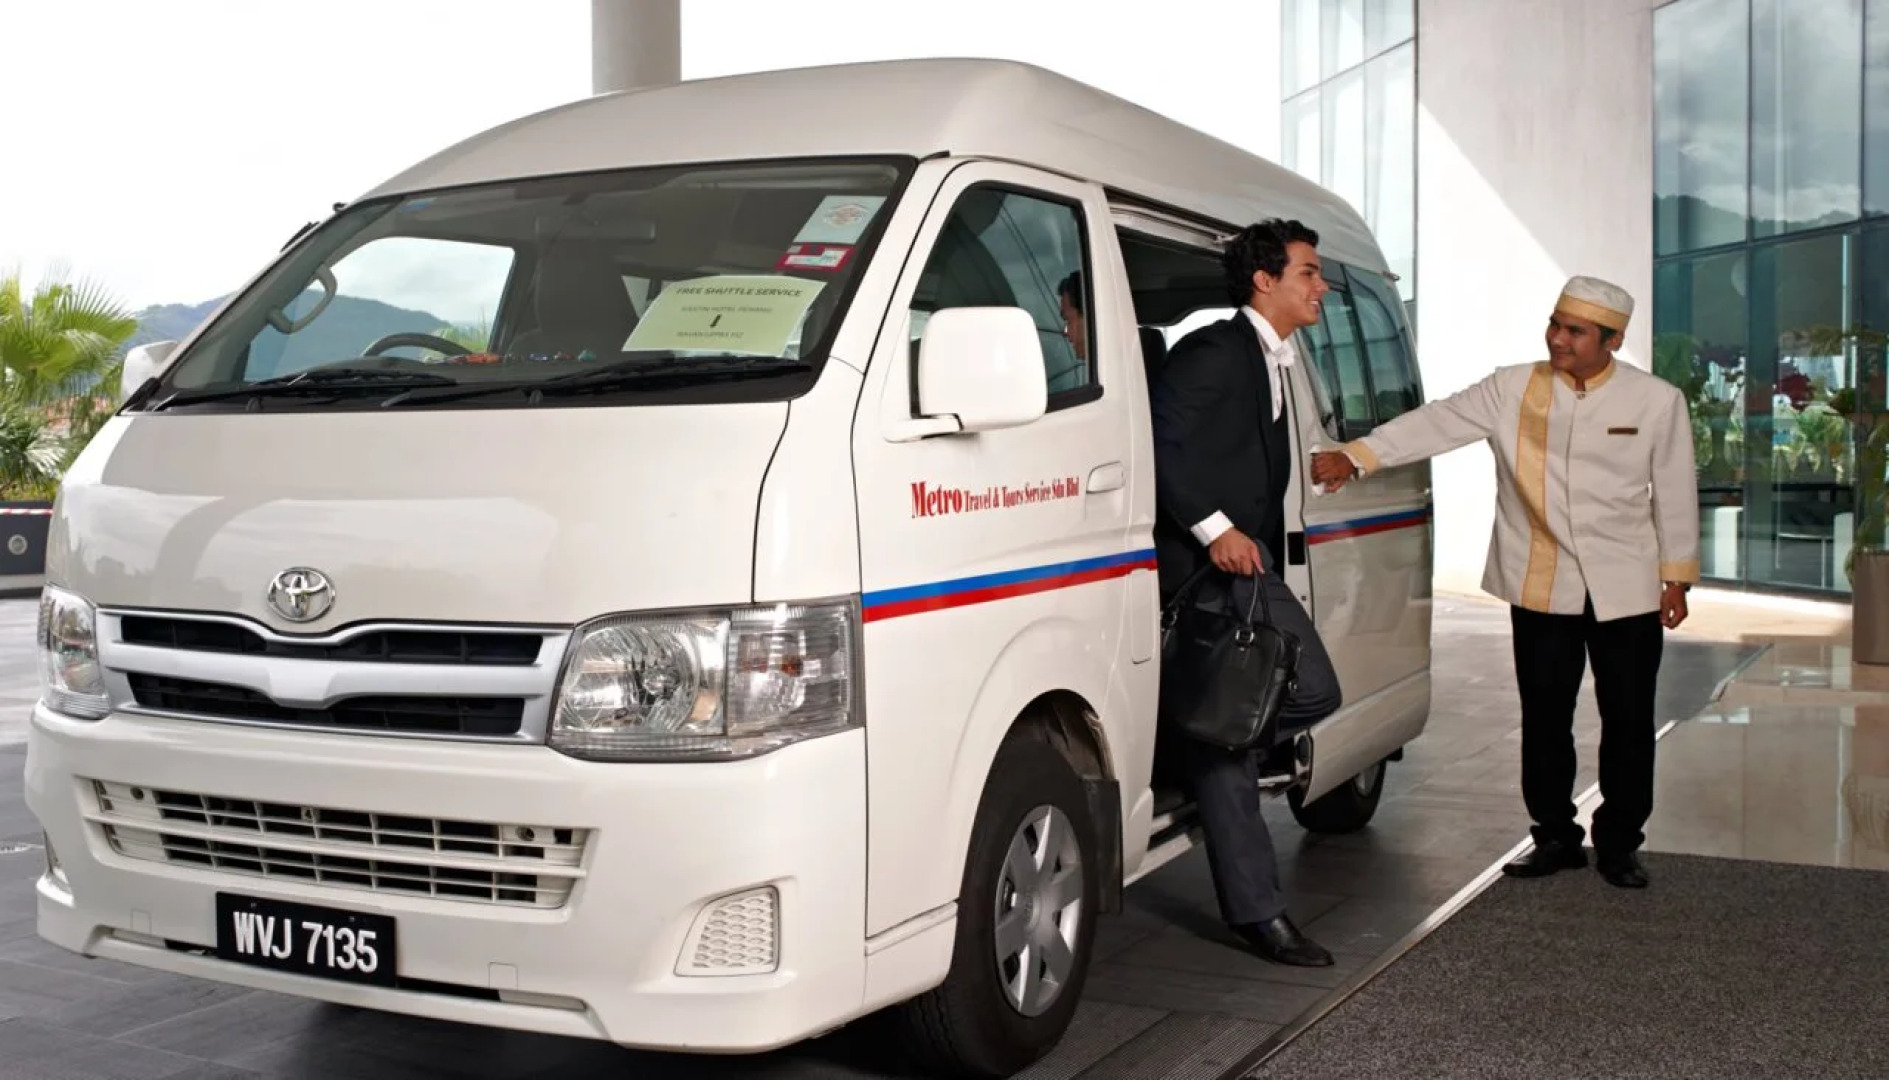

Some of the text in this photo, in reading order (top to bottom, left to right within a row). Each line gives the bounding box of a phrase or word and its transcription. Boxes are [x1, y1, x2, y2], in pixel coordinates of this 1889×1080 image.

[676, 287, 803, 297] FREE SHUTTLE SERVICE
[911, 481, 963, 518] Metro
[964, 486, 991, 512] Travel
[993, 486, 999, 508] &
[1002, 485, 1023, 507] Tours
[1024, 480, 1051, 503] Service
[232, 910, 378, 974] WVJ 7135
